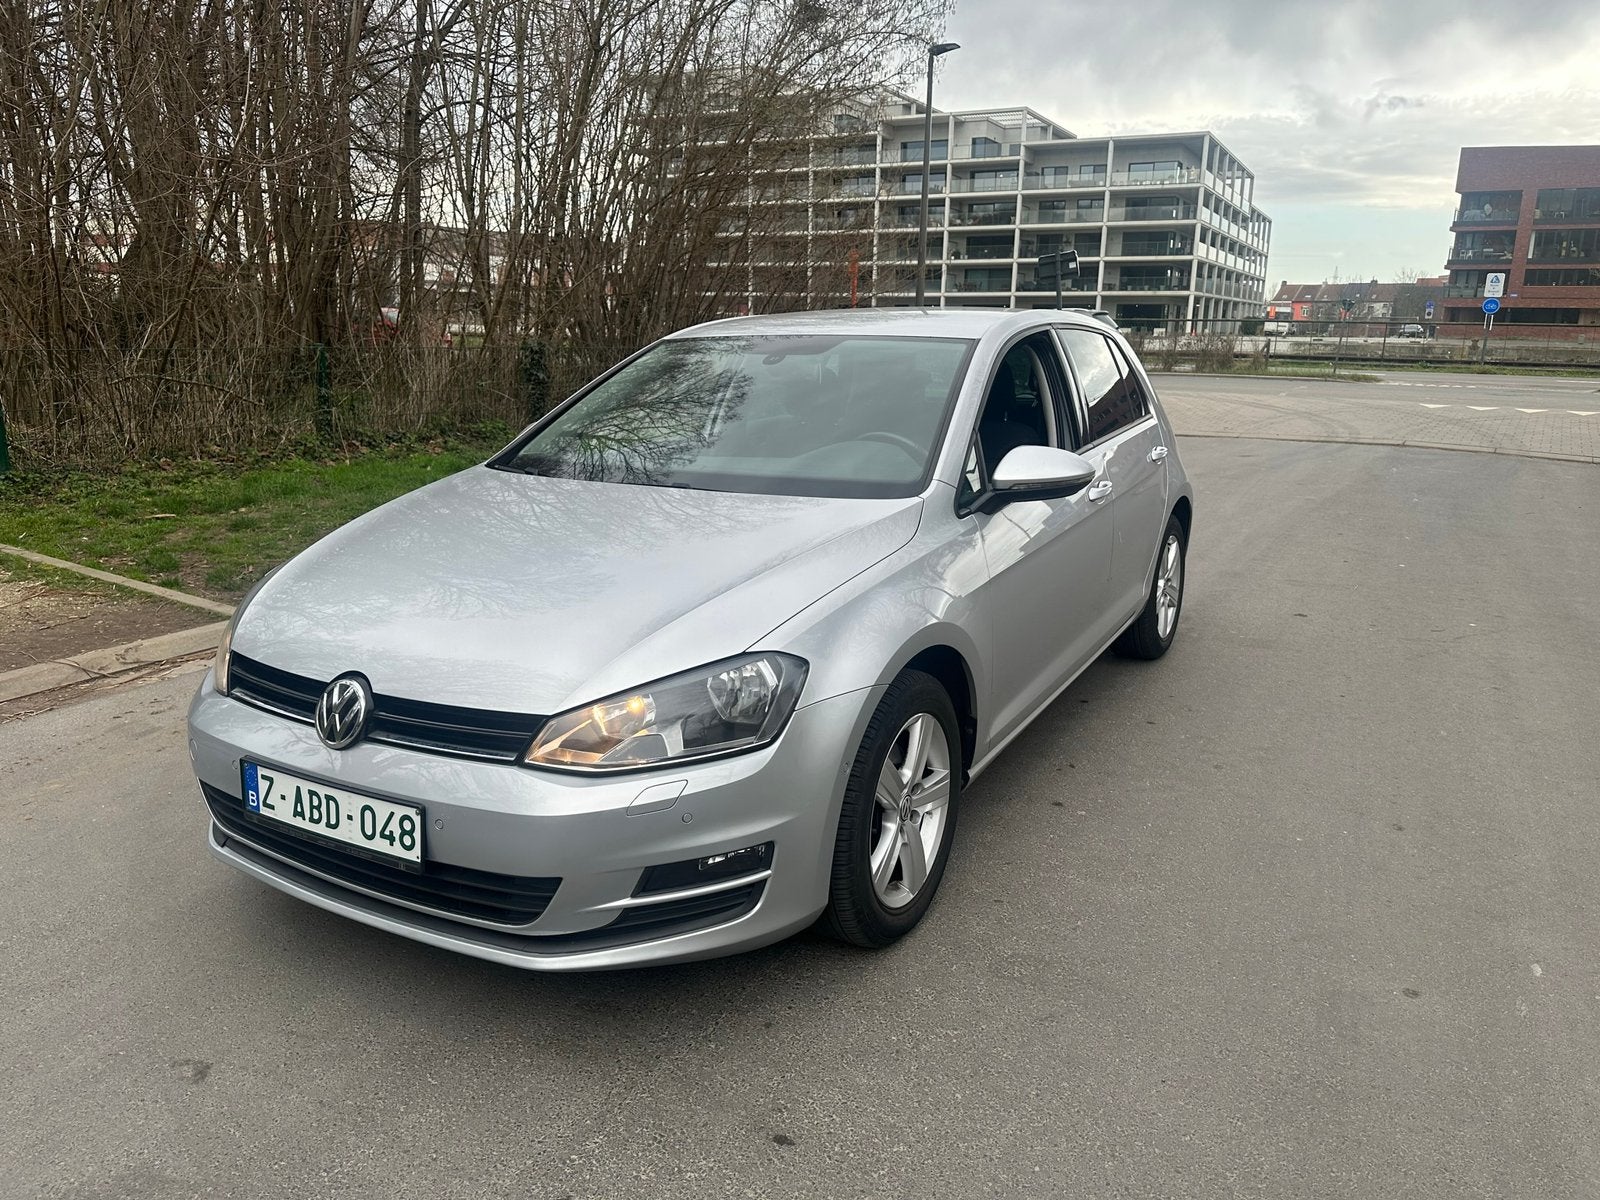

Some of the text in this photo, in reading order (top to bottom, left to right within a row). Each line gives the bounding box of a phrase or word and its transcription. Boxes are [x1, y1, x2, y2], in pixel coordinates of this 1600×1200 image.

[319, 681, 364, 745] VW
[248, 790, 258, 807] B
[260, 773, 416, 851] Z-ABD-048
